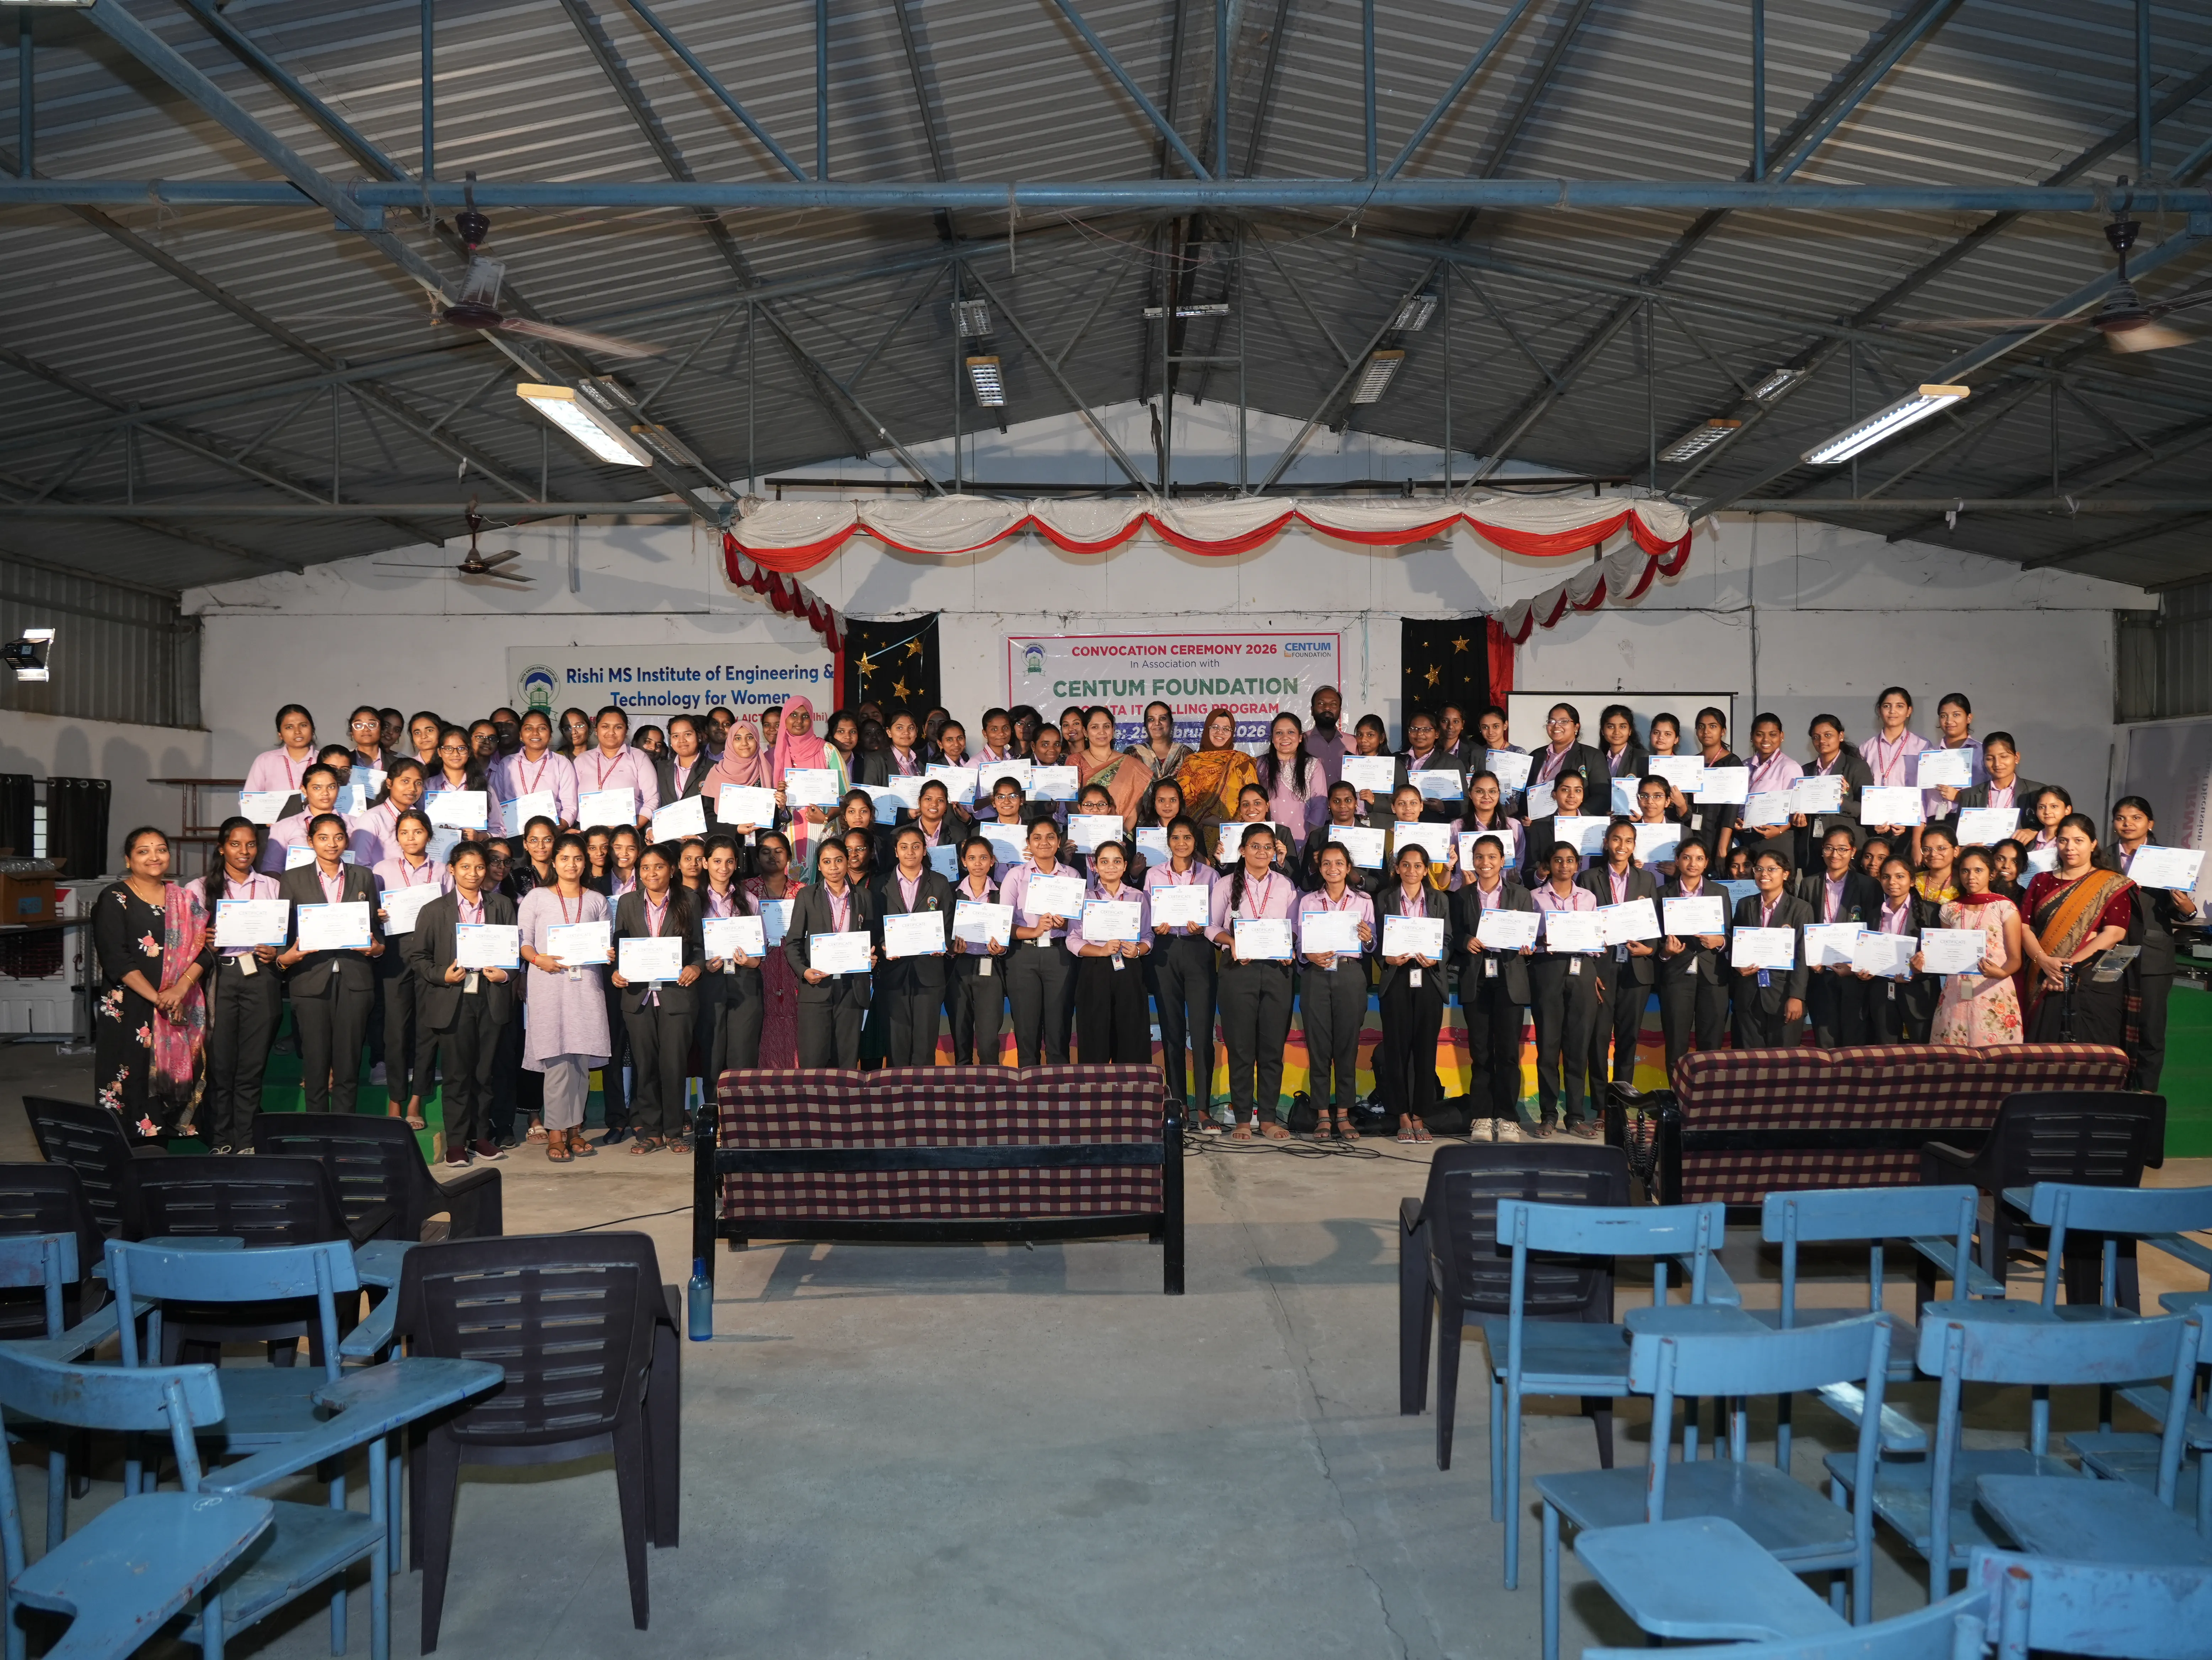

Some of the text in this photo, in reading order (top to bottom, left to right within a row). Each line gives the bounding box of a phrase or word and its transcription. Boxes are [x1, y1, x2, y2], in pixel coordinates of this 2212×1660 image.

[1072, 644, 1277, 656] CONVOCATION CEREMONY 2026
[1285, 643, 1331, 651] CENTUM
[1142, 659, 1196, 668] Association
[1200, 659, 1219, 667] with
[567, 664, 834, 684] Rishi MS Institute of Engineering &
[1053, 677, 1298, 697] CENTUM FOUNDATION
[611, 690, 790, 709] Technology for Women
[1131, 705, 1143, 715] IT
[742, 713, 763, 722] AICT
